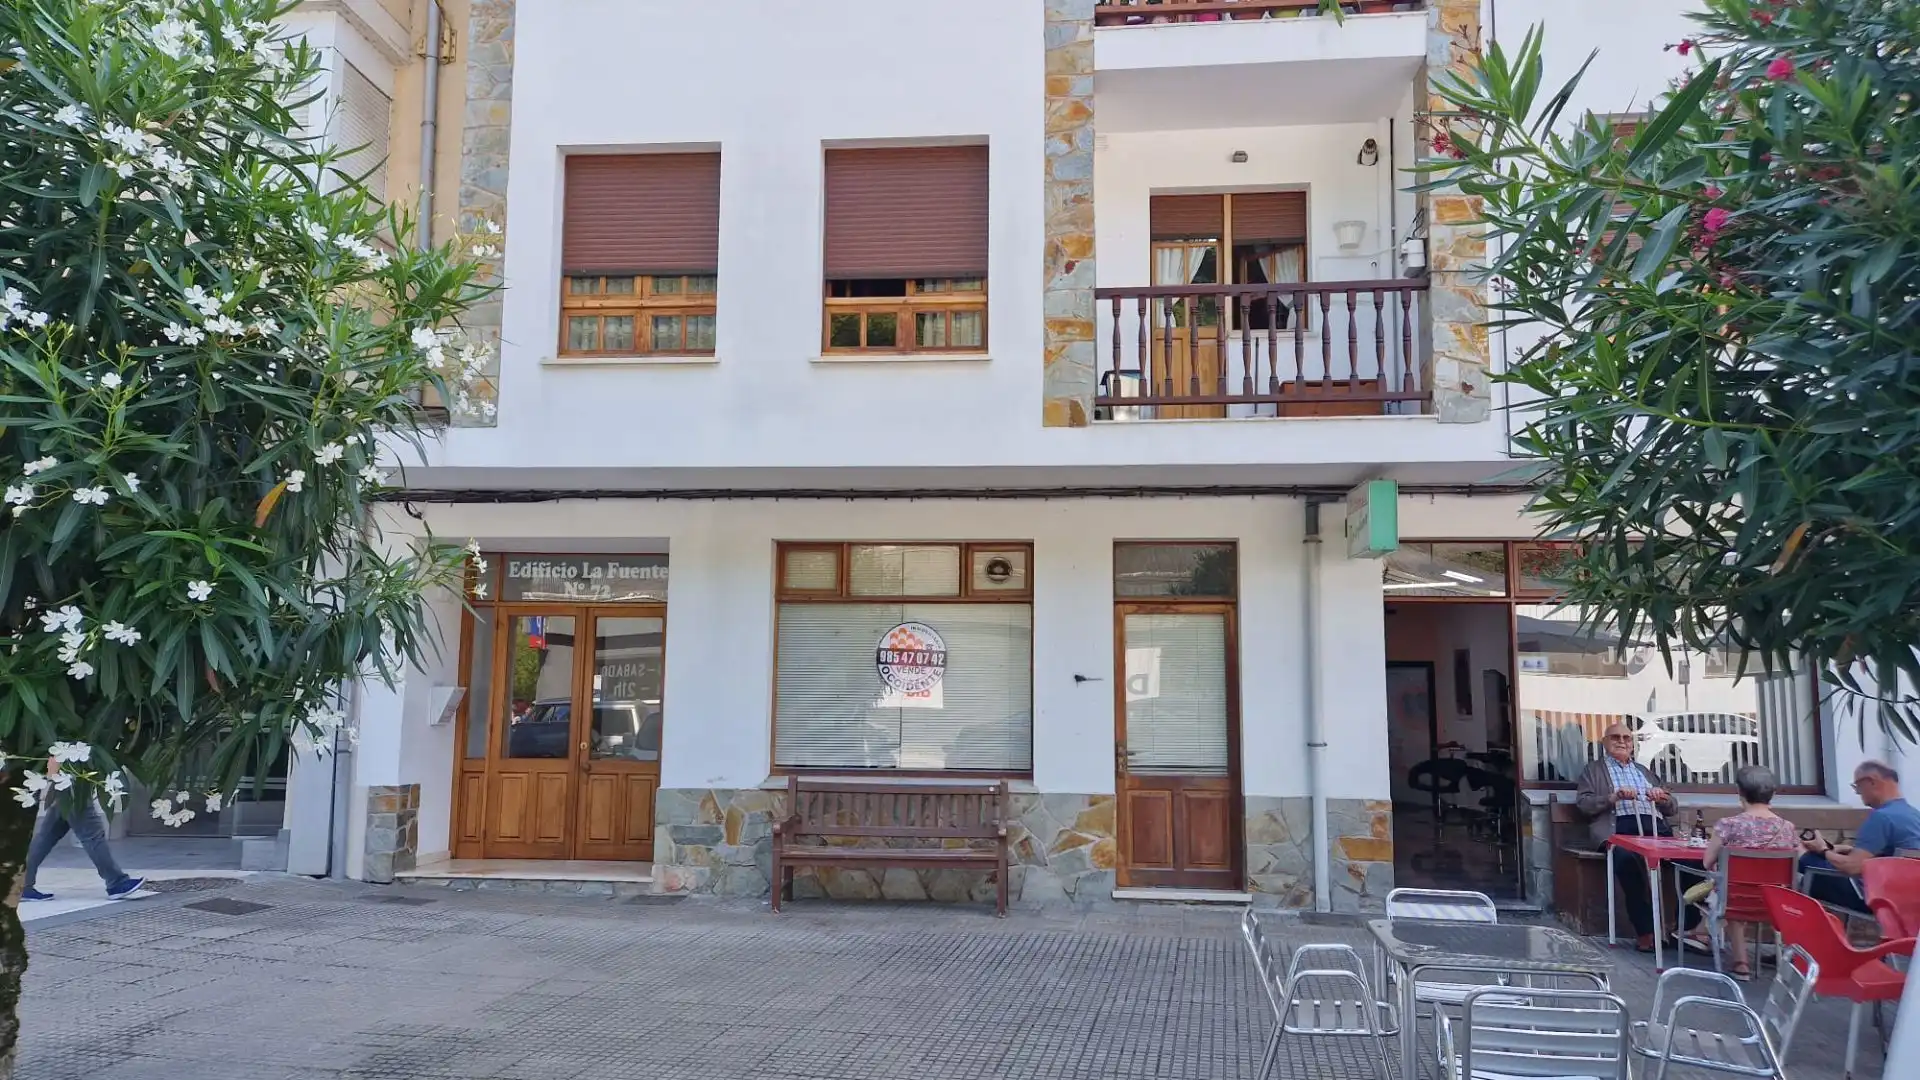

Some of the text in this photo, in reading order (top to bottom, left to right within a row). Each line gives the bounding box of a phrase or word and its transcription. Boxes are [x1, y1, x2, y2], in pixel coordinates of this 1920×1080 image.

[509, 562, 668, 579] Edificio La Fuente
[591, 585, 611, 600] 72
[896, 666, 926, 674] VENDE
